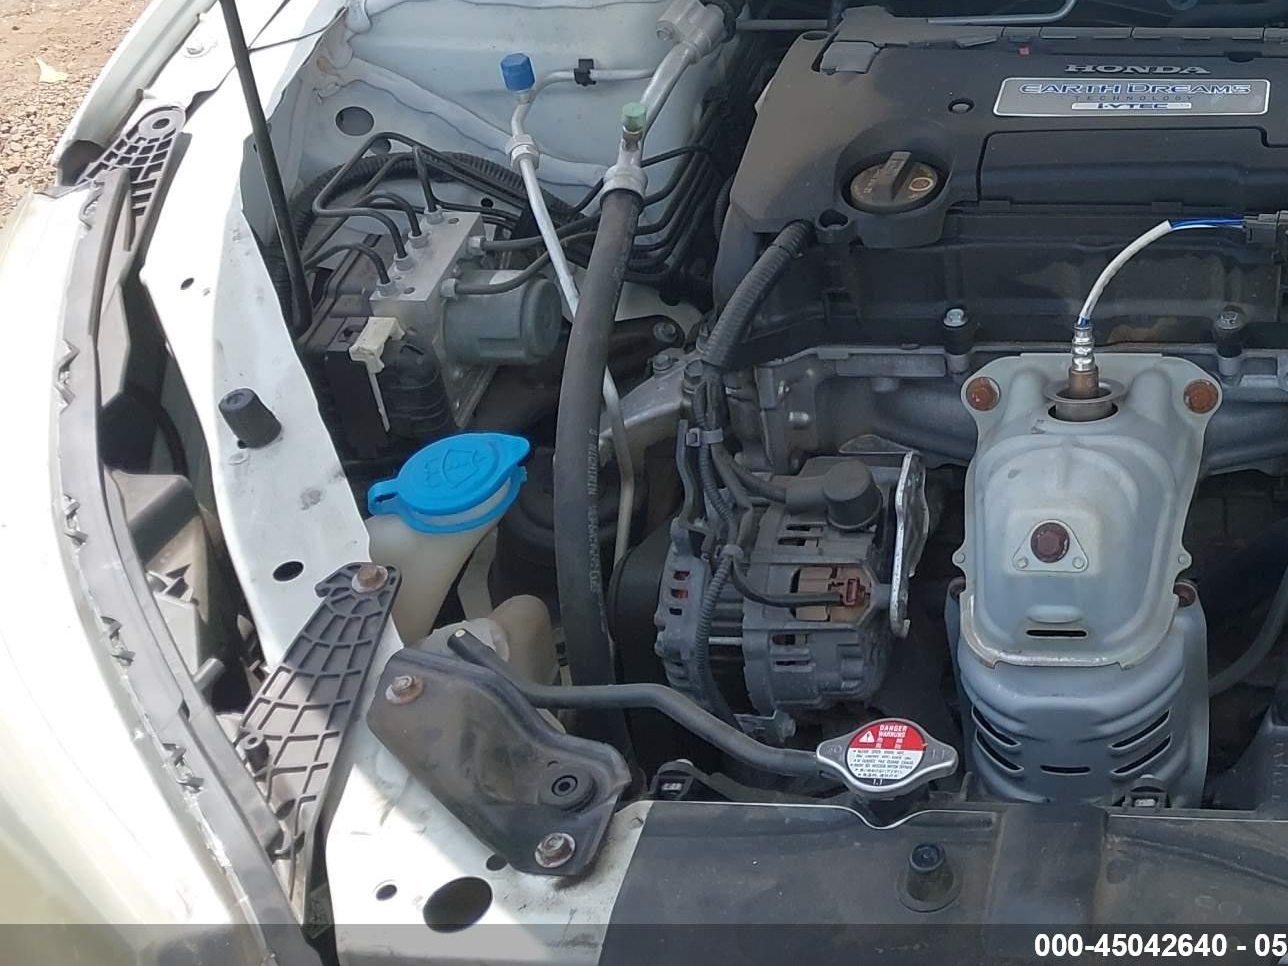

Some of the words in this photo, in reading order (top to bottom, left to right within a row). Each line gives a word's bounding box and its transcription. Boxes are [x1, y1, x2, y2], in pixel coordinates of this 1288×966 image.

[1064, 64, 1211, 74] HONDA
[1019, 83, 1120, 95] EARTH
[1127, 83, 1252, 95] DREAMS
